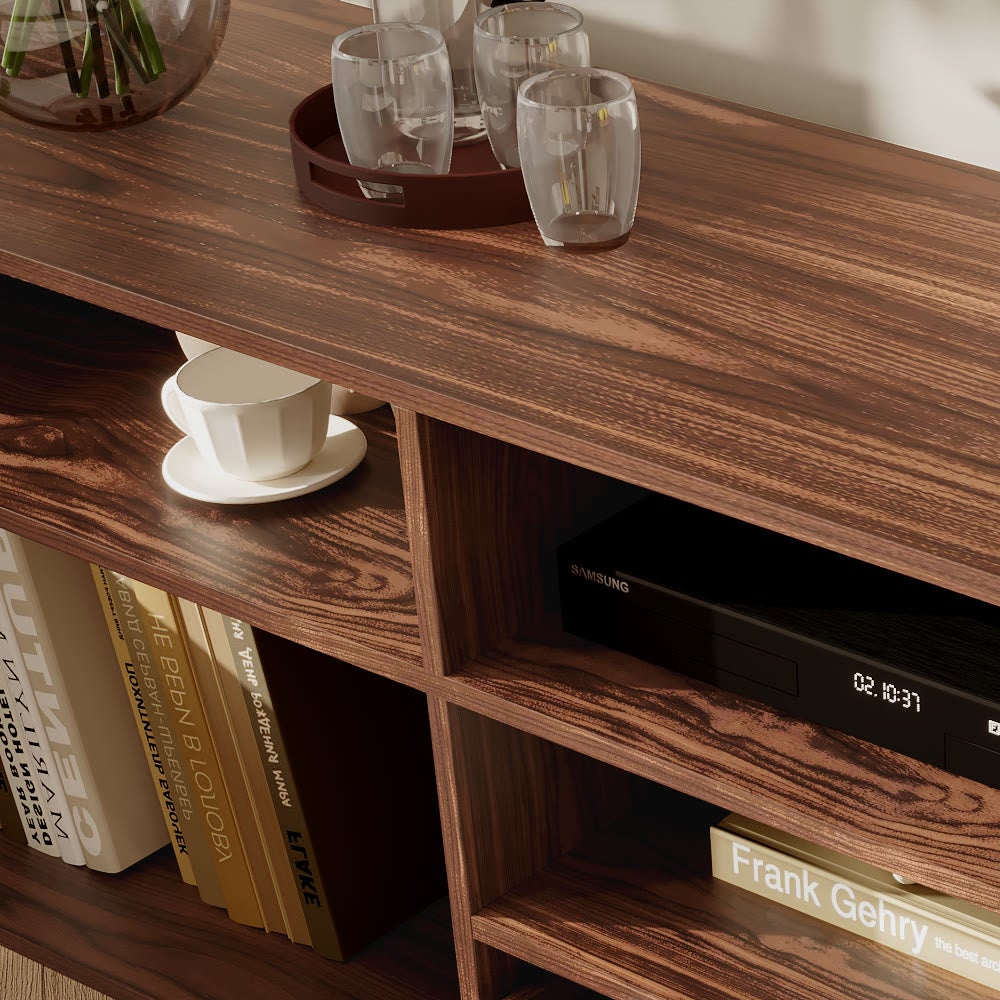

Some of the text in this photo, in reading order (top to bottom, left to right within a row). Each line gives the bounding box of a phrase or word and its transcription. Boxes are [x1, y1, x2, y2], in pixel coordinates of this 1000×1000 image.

[571, 564, 629, 593] SAMSUNG
[732, 841, 820, 907] Frank
[831, 883, 928, 954] Gehry
[934, 936, 952, 953] the
[955, 944, 979, 965] best
